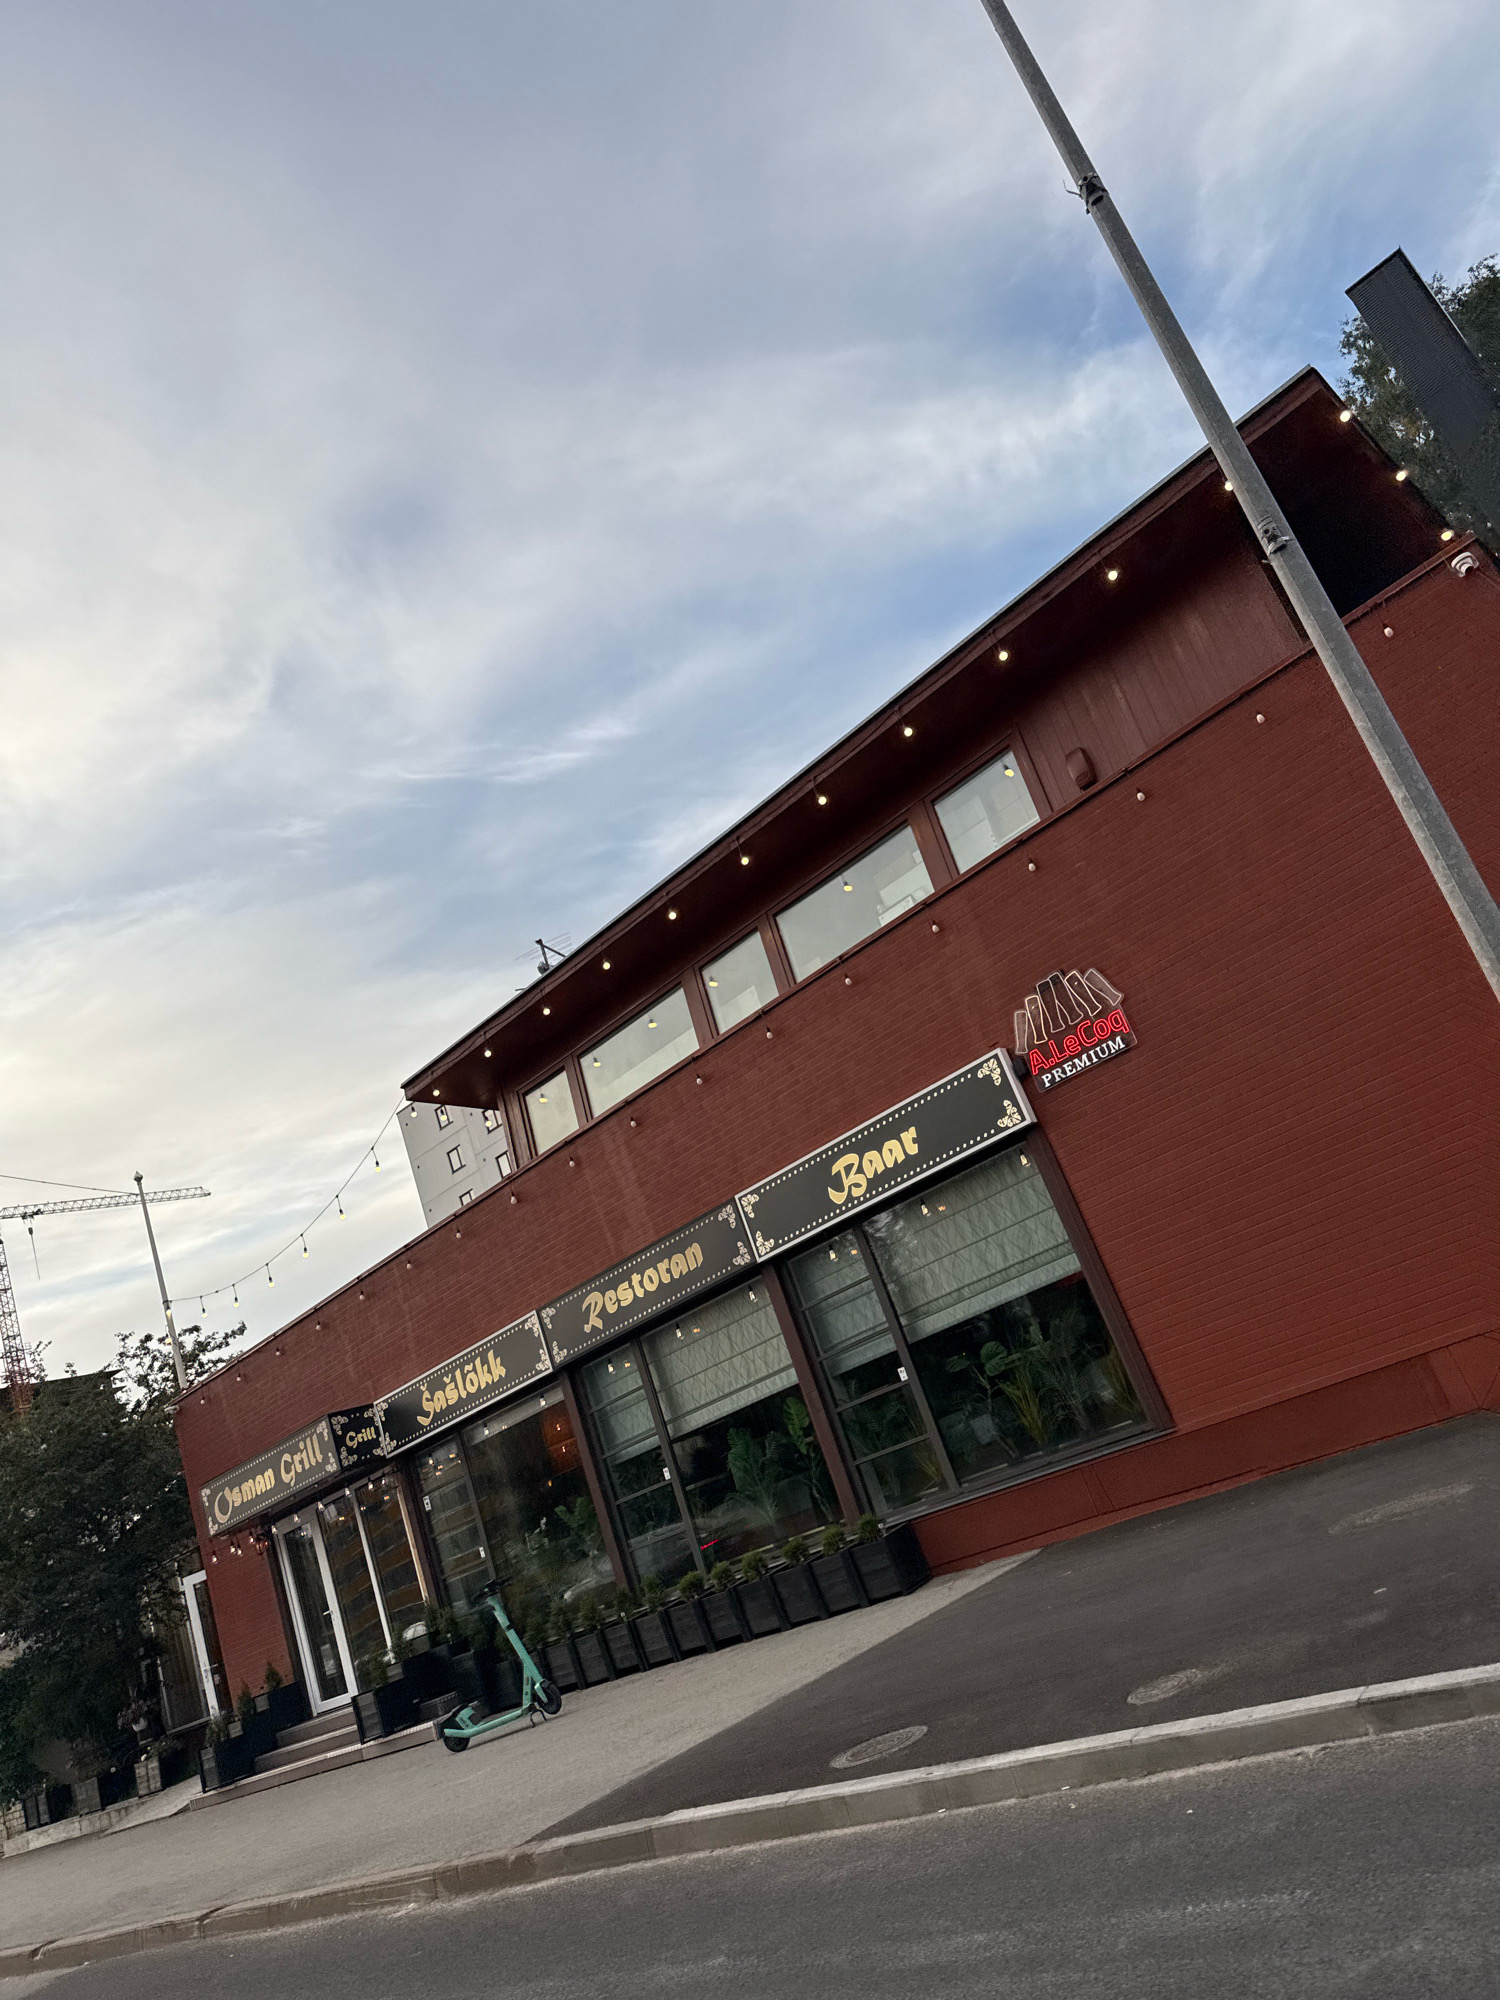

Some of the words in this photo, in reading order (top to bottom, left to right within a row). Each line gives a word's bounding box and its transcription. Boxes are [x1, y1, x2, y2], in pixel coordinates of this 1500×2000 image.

[1041, 1035, 1126, 1088] PREMIUM
[827, 1126, 919, 1205] Baar
[581, 1242, 704, 1334] Restoran
[416, 1349, 506, 1426] Šašlõkk
[345, 1426, 377, 1449] Grill
[214, 1469, 275, 1524] Osman
[280, 1436, 323, 1486] Grill
